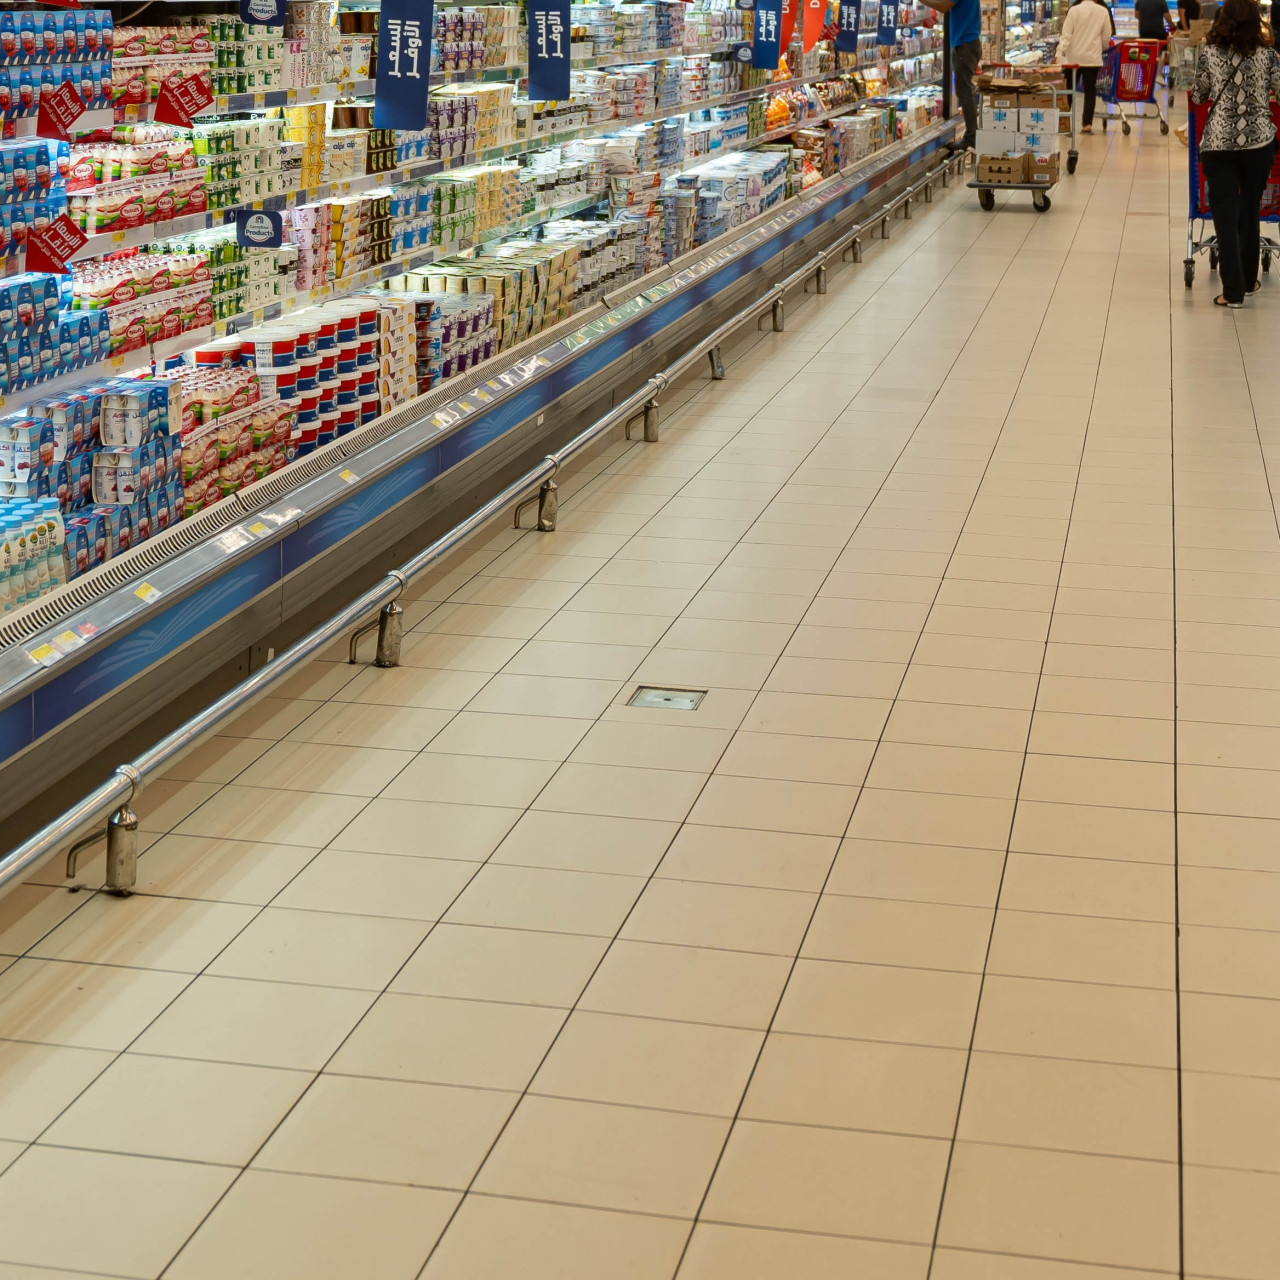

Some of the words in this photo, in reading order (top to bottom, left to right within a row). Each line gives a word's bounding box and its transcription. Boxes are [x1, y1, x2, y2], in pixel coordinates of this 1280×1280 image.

[388, 19, 402, 78] السعر
[404, 20, 422, 79] الأوفر
[535, 11, 548, 58] السعر
[184, 79, 208, 105] الأسعار
[244, 228, 273, 239] Products
